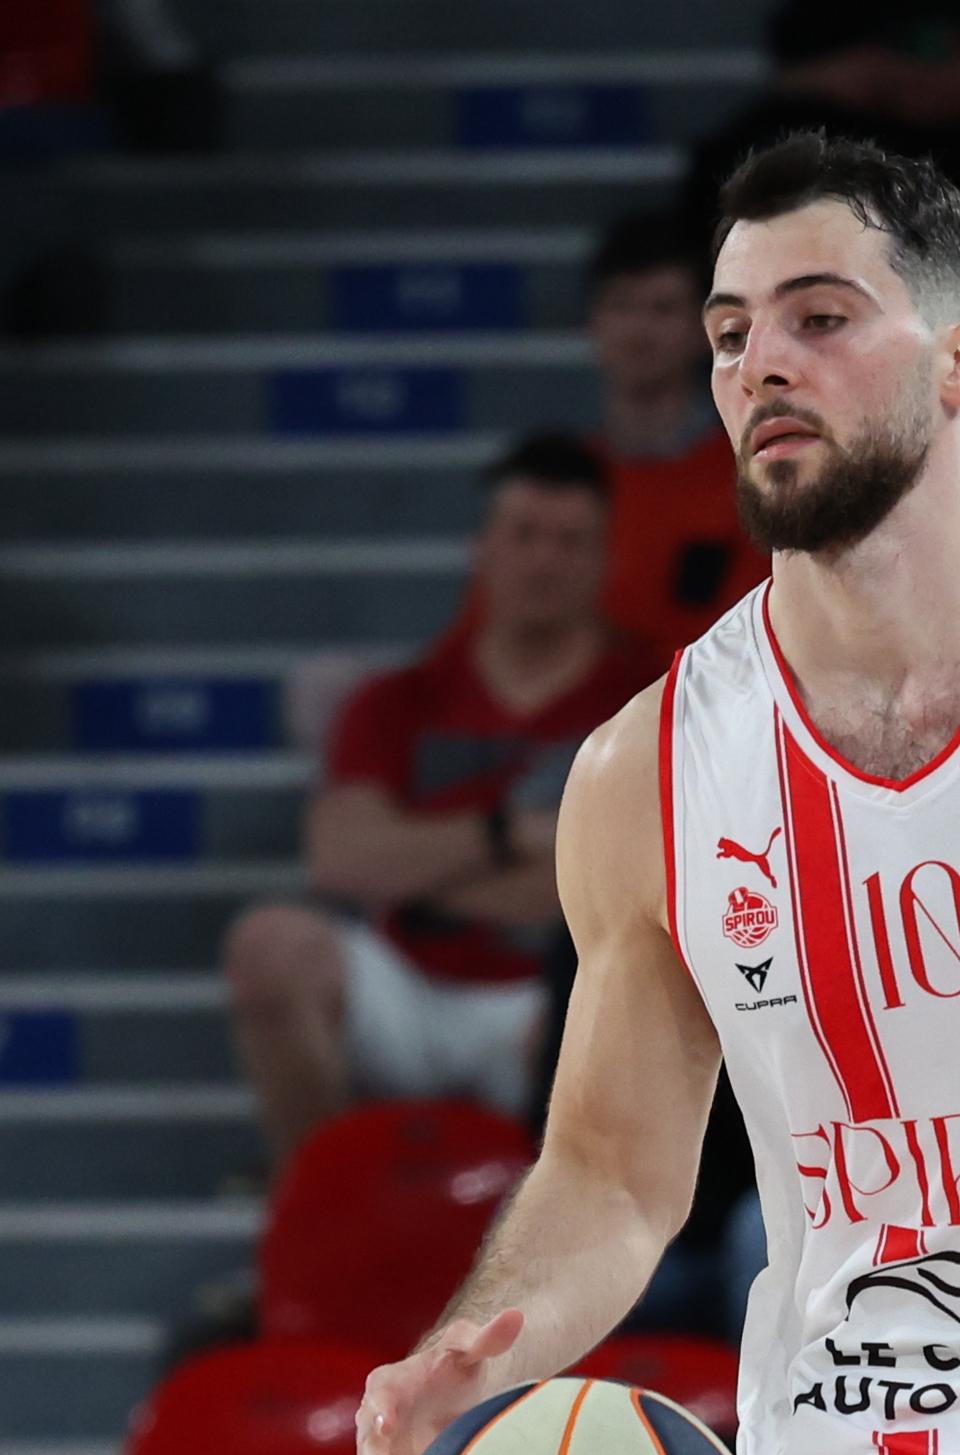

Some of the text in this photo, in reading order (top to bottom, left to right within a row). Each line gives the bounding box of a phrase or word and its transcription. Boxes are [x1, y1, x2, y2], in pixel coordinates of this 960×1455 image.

[725, 910, 775, 932] SPIROU
[735, 995, 798, 1011] CUPRA
[825, 1337, 897, 1368] LE
